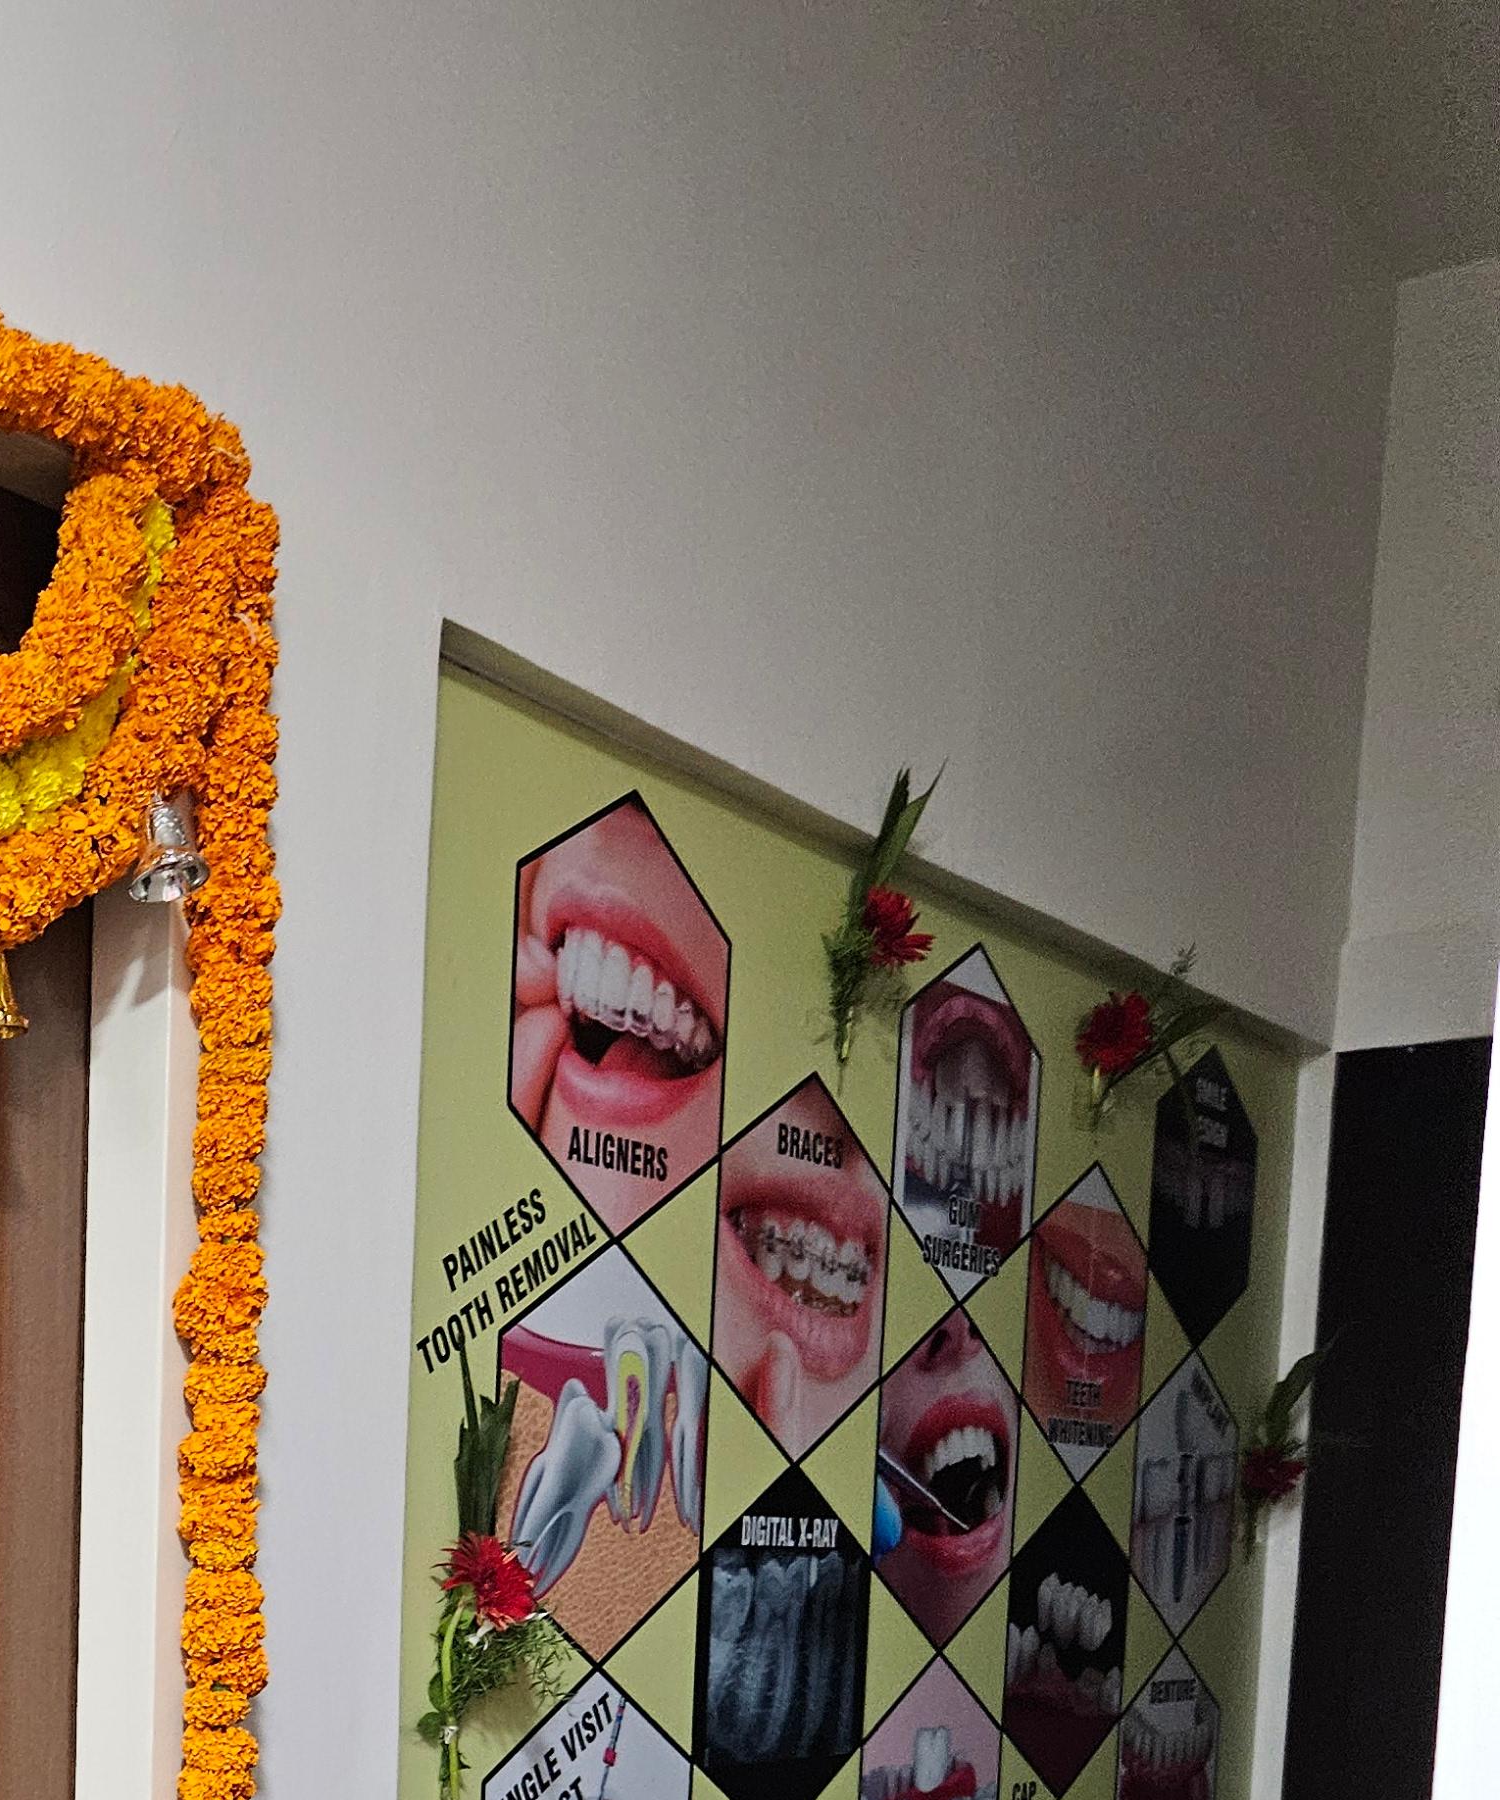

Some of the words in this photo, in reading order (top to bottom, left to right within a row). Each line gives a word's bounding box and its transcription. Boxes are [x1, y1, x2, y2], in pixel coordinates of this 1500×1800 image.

[567, 1125, 669, 1182] ALIGNERS
[777, 1122, 844, 1169] BRACES
[948, 1196, 980, 1229] GUM
[442, 1188, 547, 1292] PAINLESS
[923, 1234, 1000, 1277] SURGERIES
[416, 1290, 495, 1374] TOOTH
[495, 1212, 597, 1314] REMOVAL
[741, 1515, 795, 1547] DIGITAL
[798, 1517, 839, 1548] X-RAY
[560, 1692, 613, 1762] VISIT
